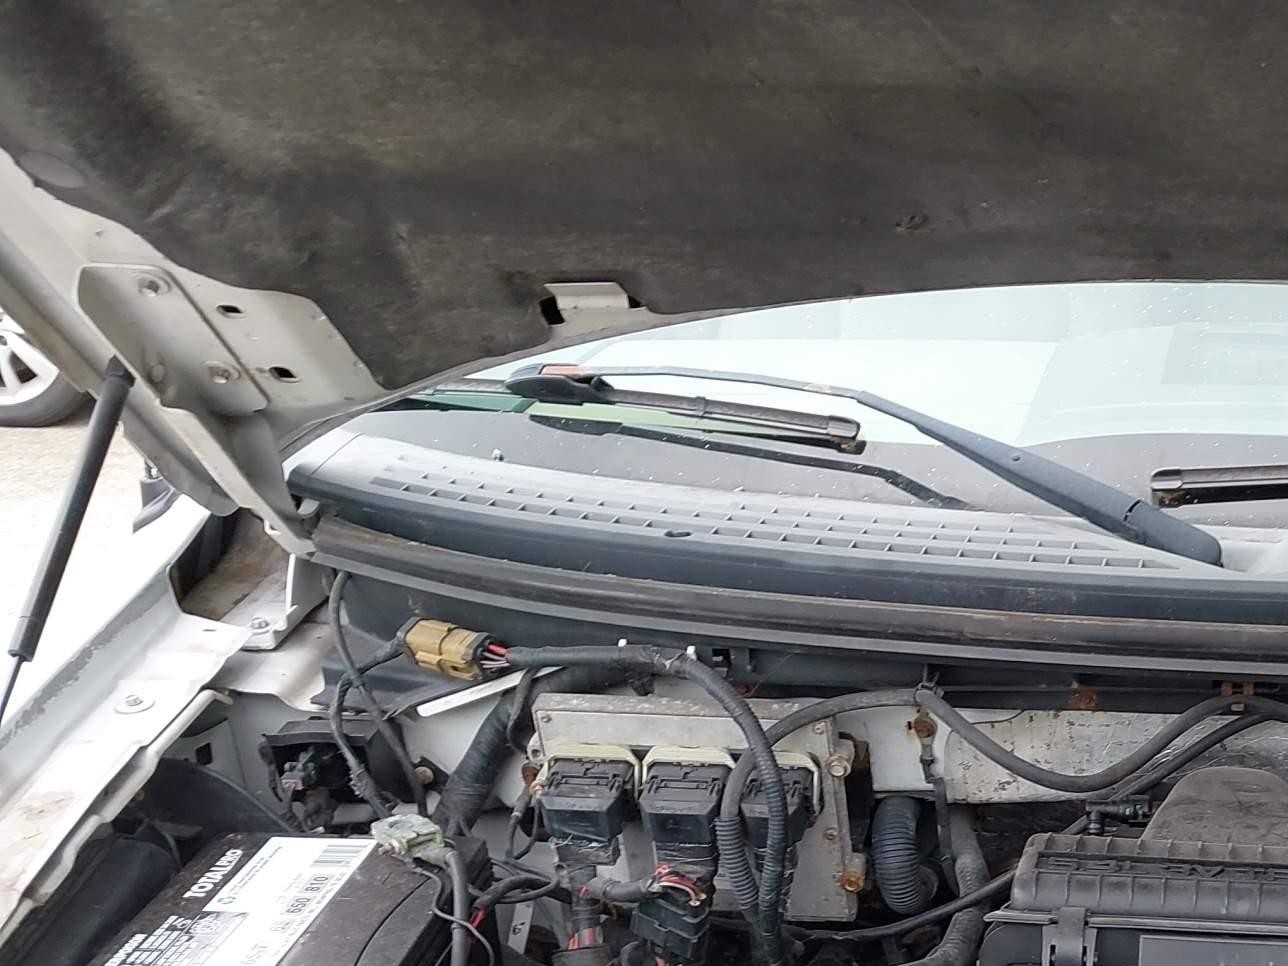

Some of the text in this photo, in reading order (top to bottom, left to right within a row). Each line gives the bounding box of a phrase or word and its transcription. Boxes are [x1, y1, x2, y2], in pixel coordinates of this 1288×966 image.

[183, 849, 244, 898] TOTALPRO
[286, 876, 329, 914] 650 810
